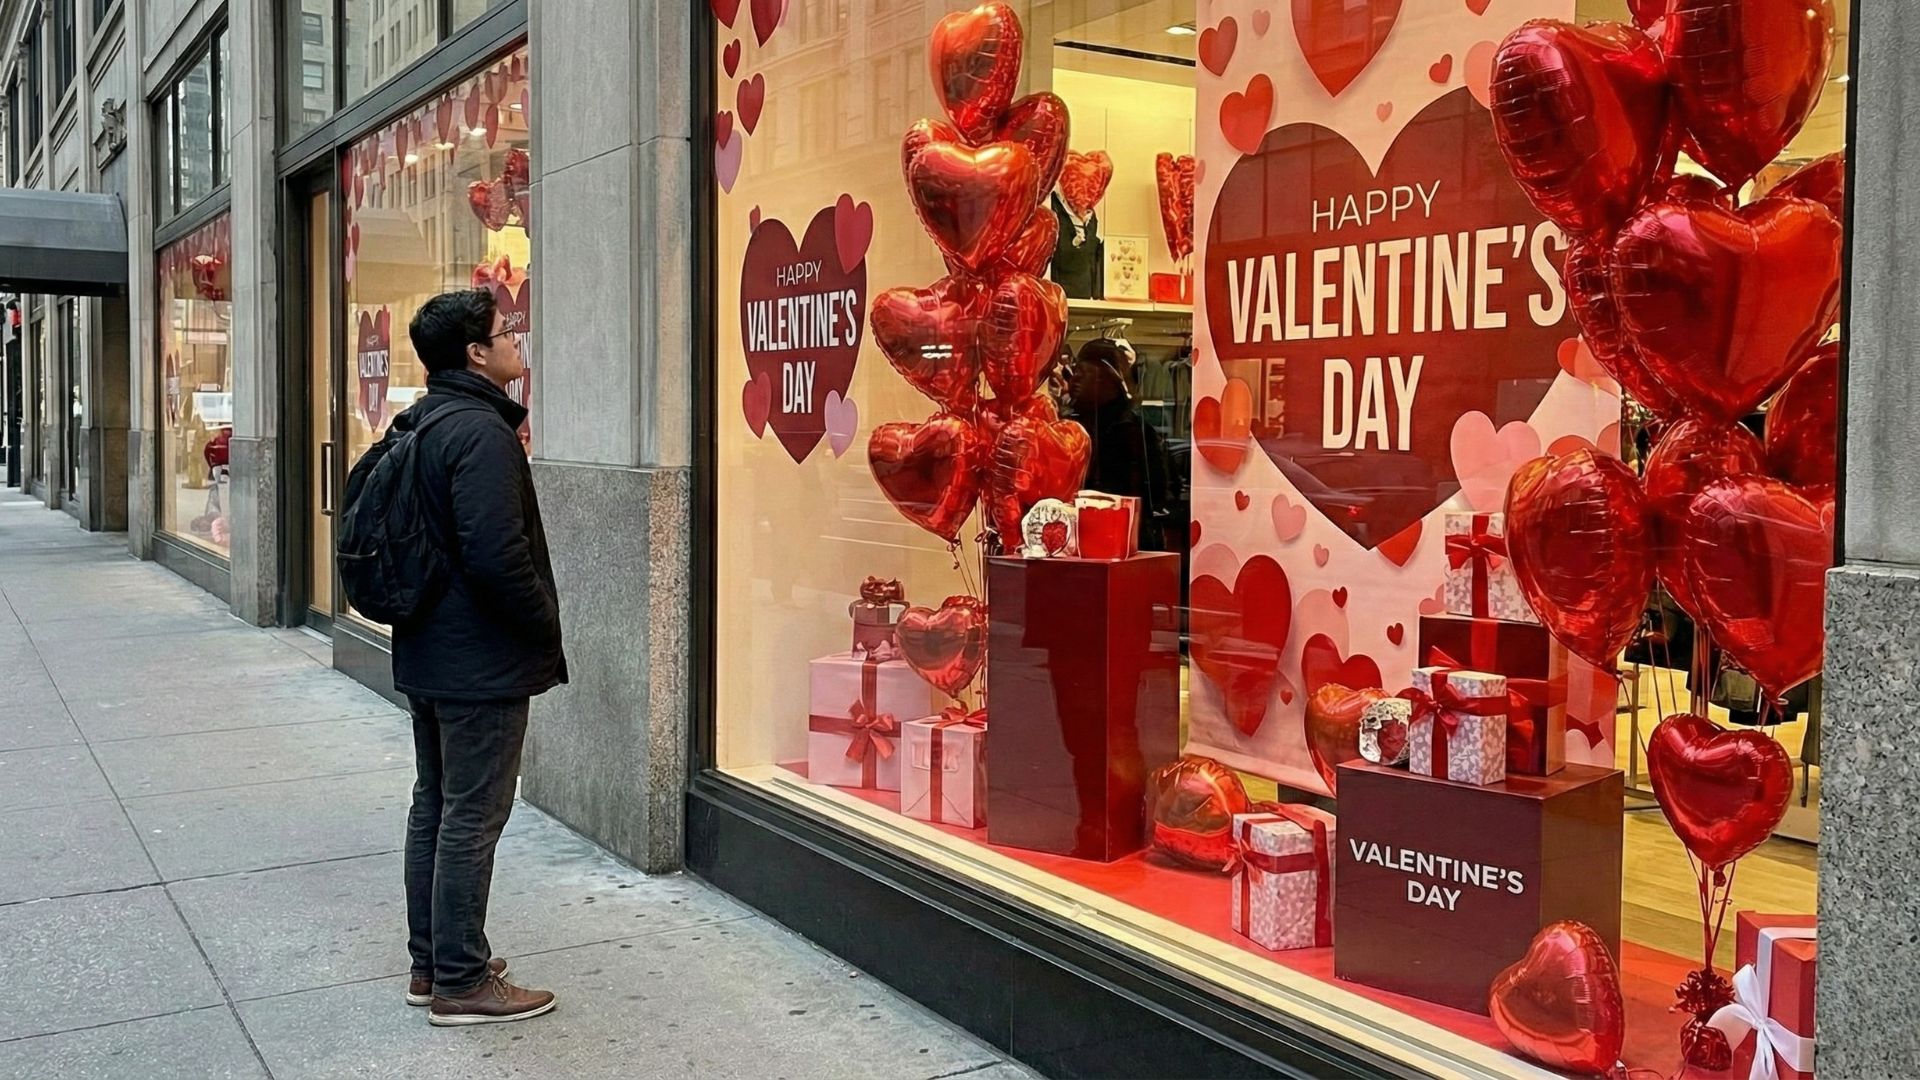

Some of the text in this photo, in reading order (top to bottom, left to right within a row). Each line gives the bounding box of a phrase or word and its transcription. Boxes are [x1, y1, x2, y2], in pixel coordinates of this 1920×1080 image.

[1312, 179, 1441, 233] HAPPY
[776, 260, 822, 287] HAPPY
[1227, 221, 1570, 344] VALENTINE'S
[747, 289, 857, 352] VALENTINE'S
[782, 361, 816, 414] DAY
[1322, 355, 1425, 451] DAY
[1350, 838, 1524, 895] VALENTINE'S
[1407, 880, 1461, 911] DAY
